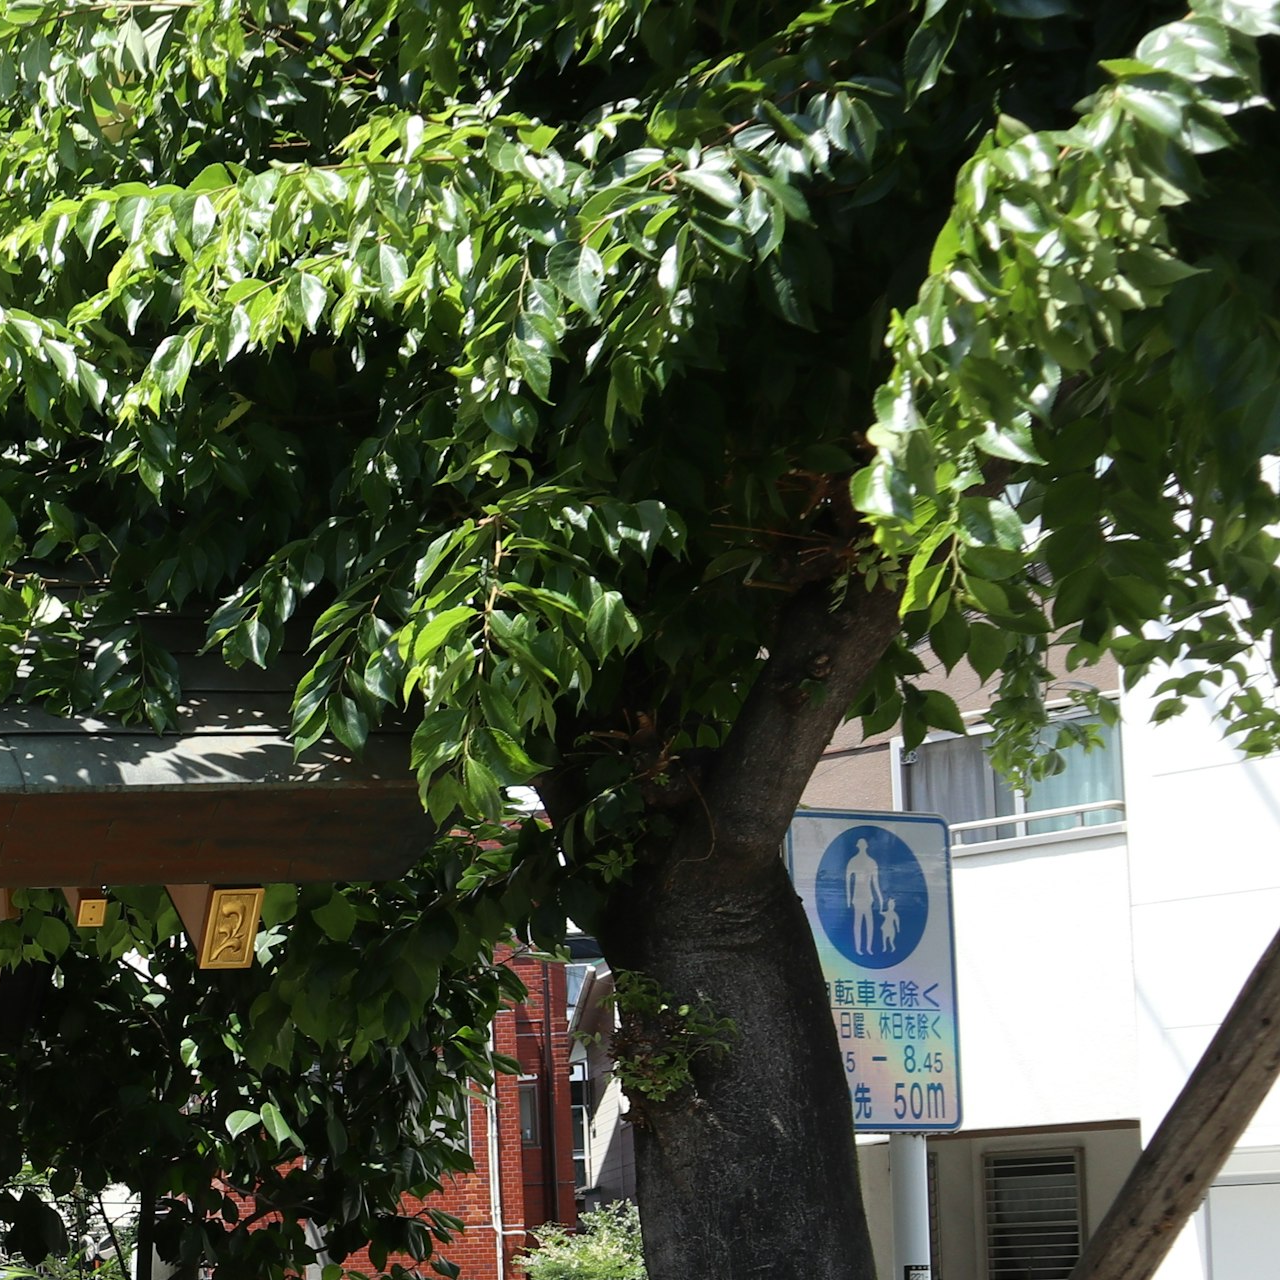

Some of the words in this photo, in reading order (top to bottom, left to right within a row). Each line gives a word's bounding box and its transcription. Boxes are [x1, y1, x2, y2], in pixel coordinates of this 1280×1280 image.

[840, 1051, 856, 1073] 5
[903, 1044, 944, 1074] 8.45
[893, 1082, 946, 1120] 50m
